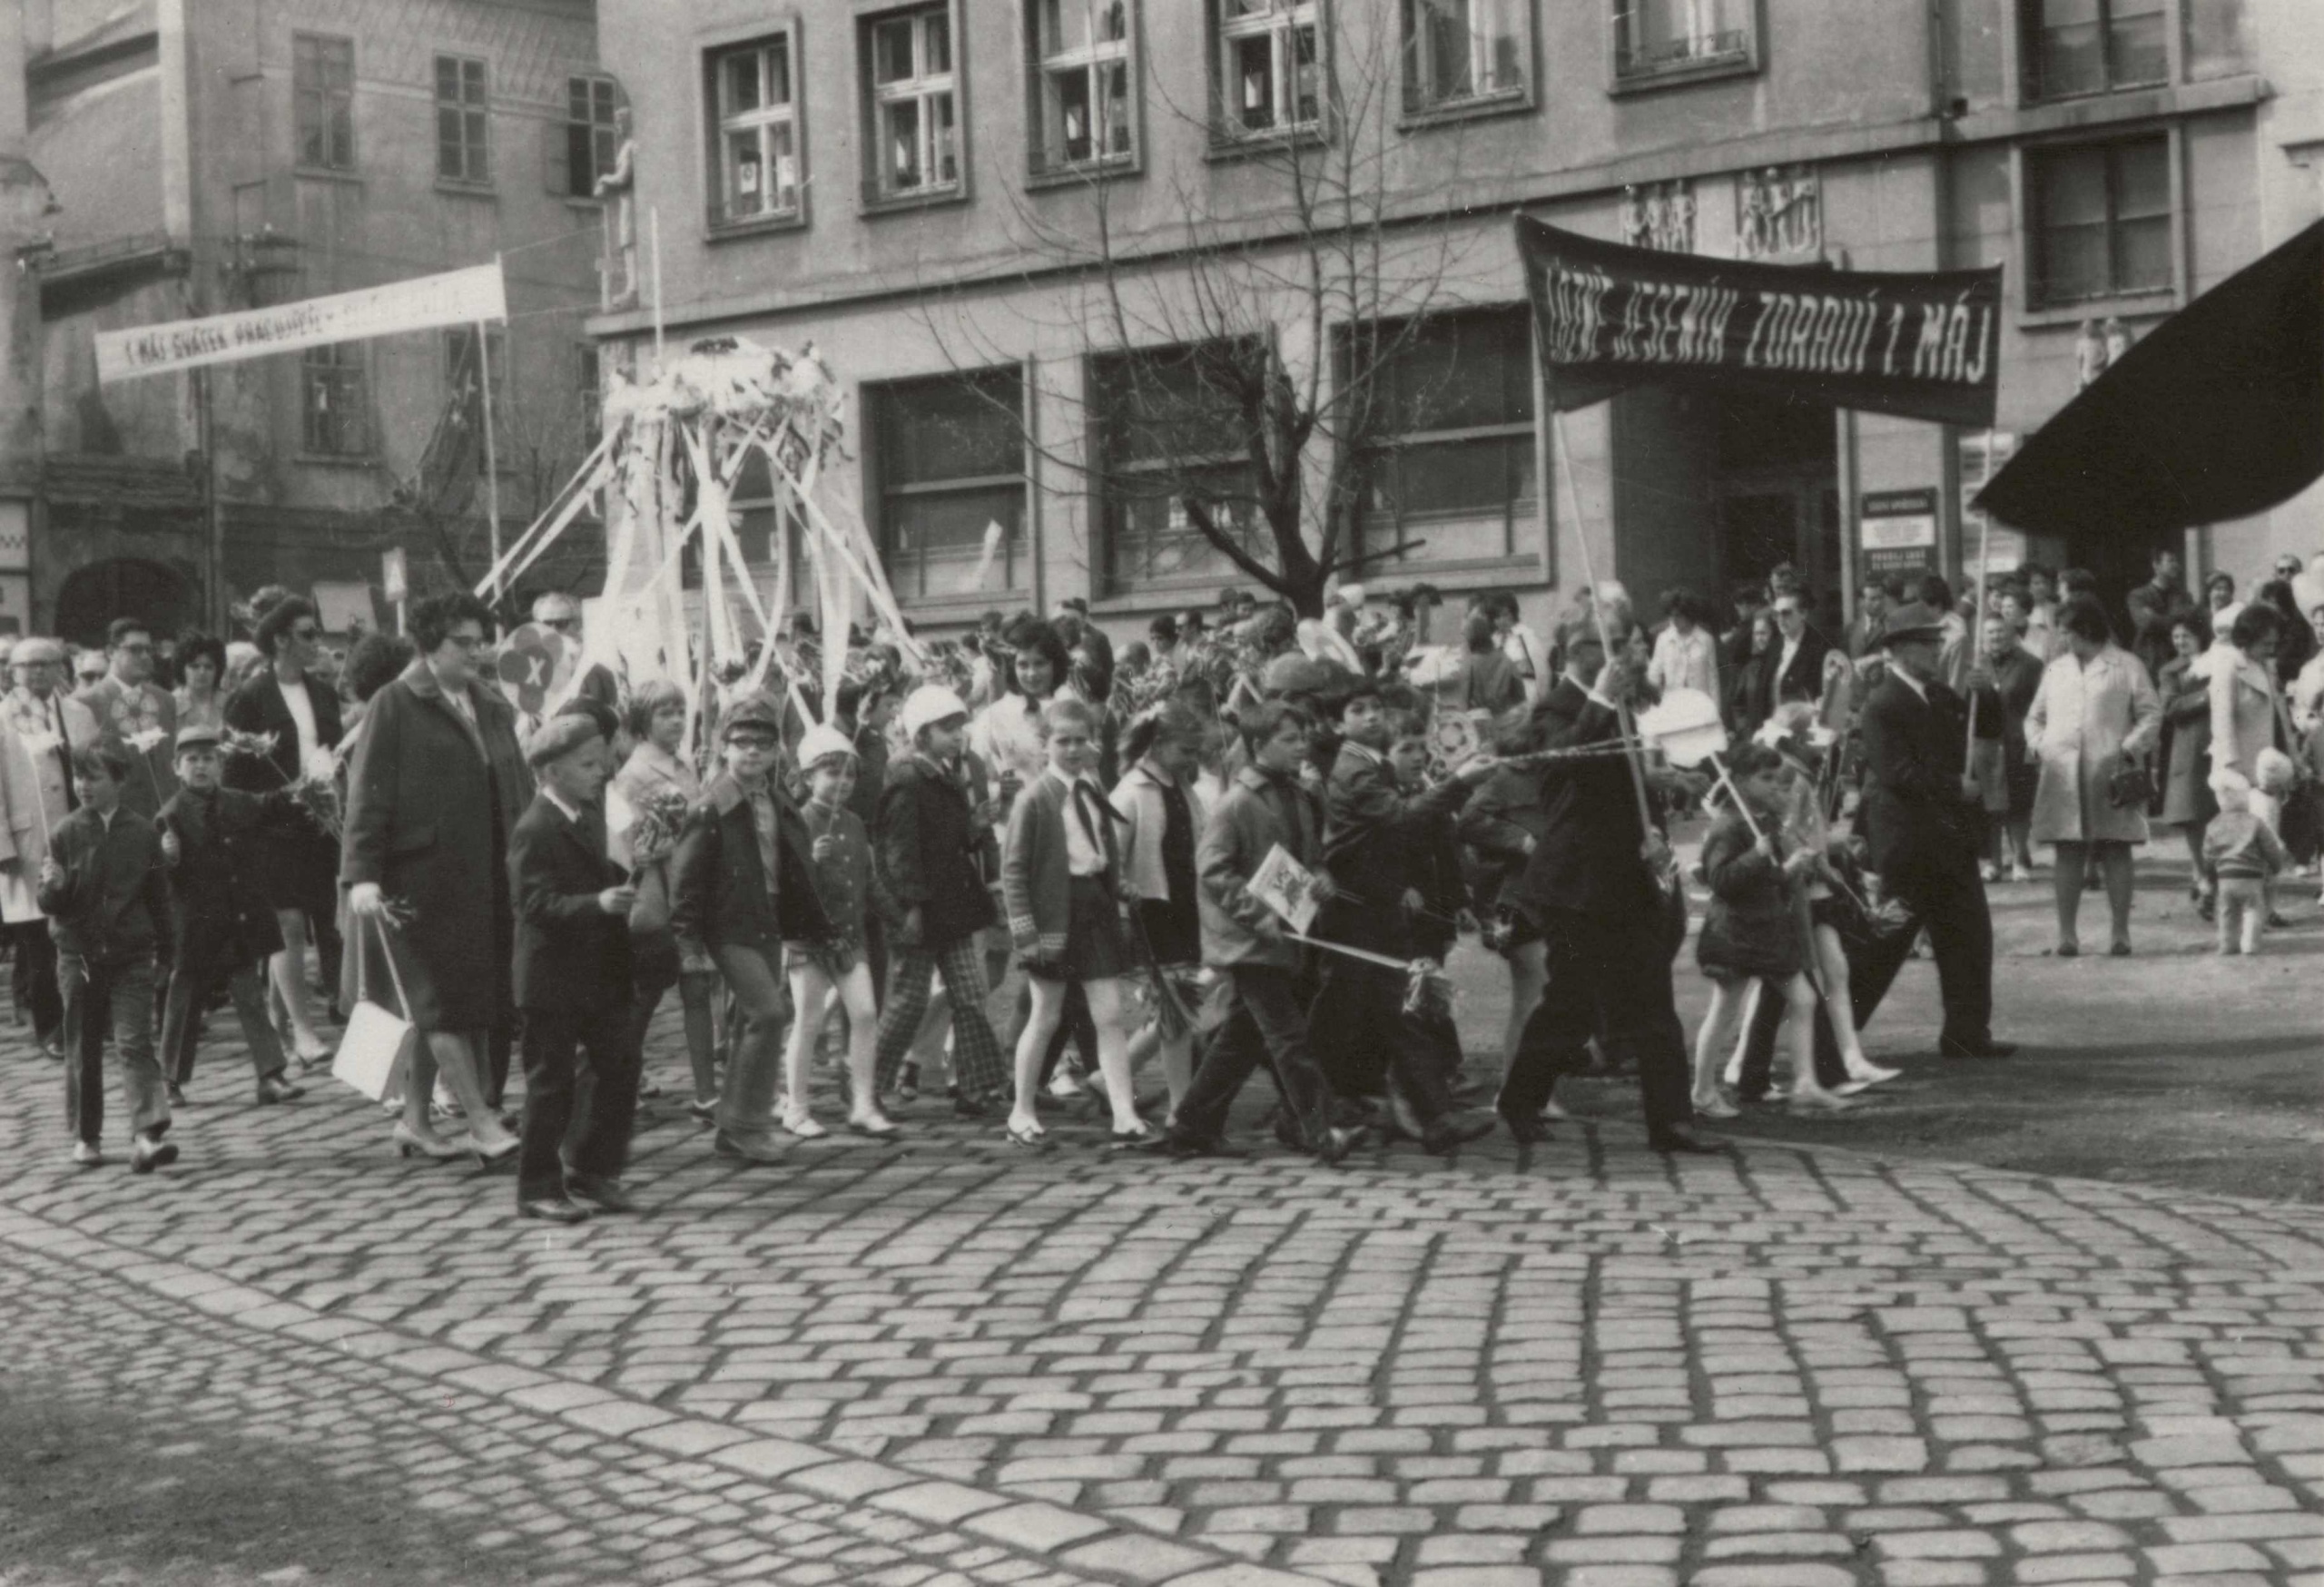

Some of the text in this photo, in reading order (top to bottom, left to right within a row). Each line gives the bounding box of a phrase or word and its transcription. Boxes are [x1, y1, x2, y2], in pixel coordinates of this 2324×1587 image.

[1613, 275, 1738, 362] JESENÍK
[1743, 288, 1880, 373] ZDRAVÍ
[1911, 289, 1991, 384] MÁJ
